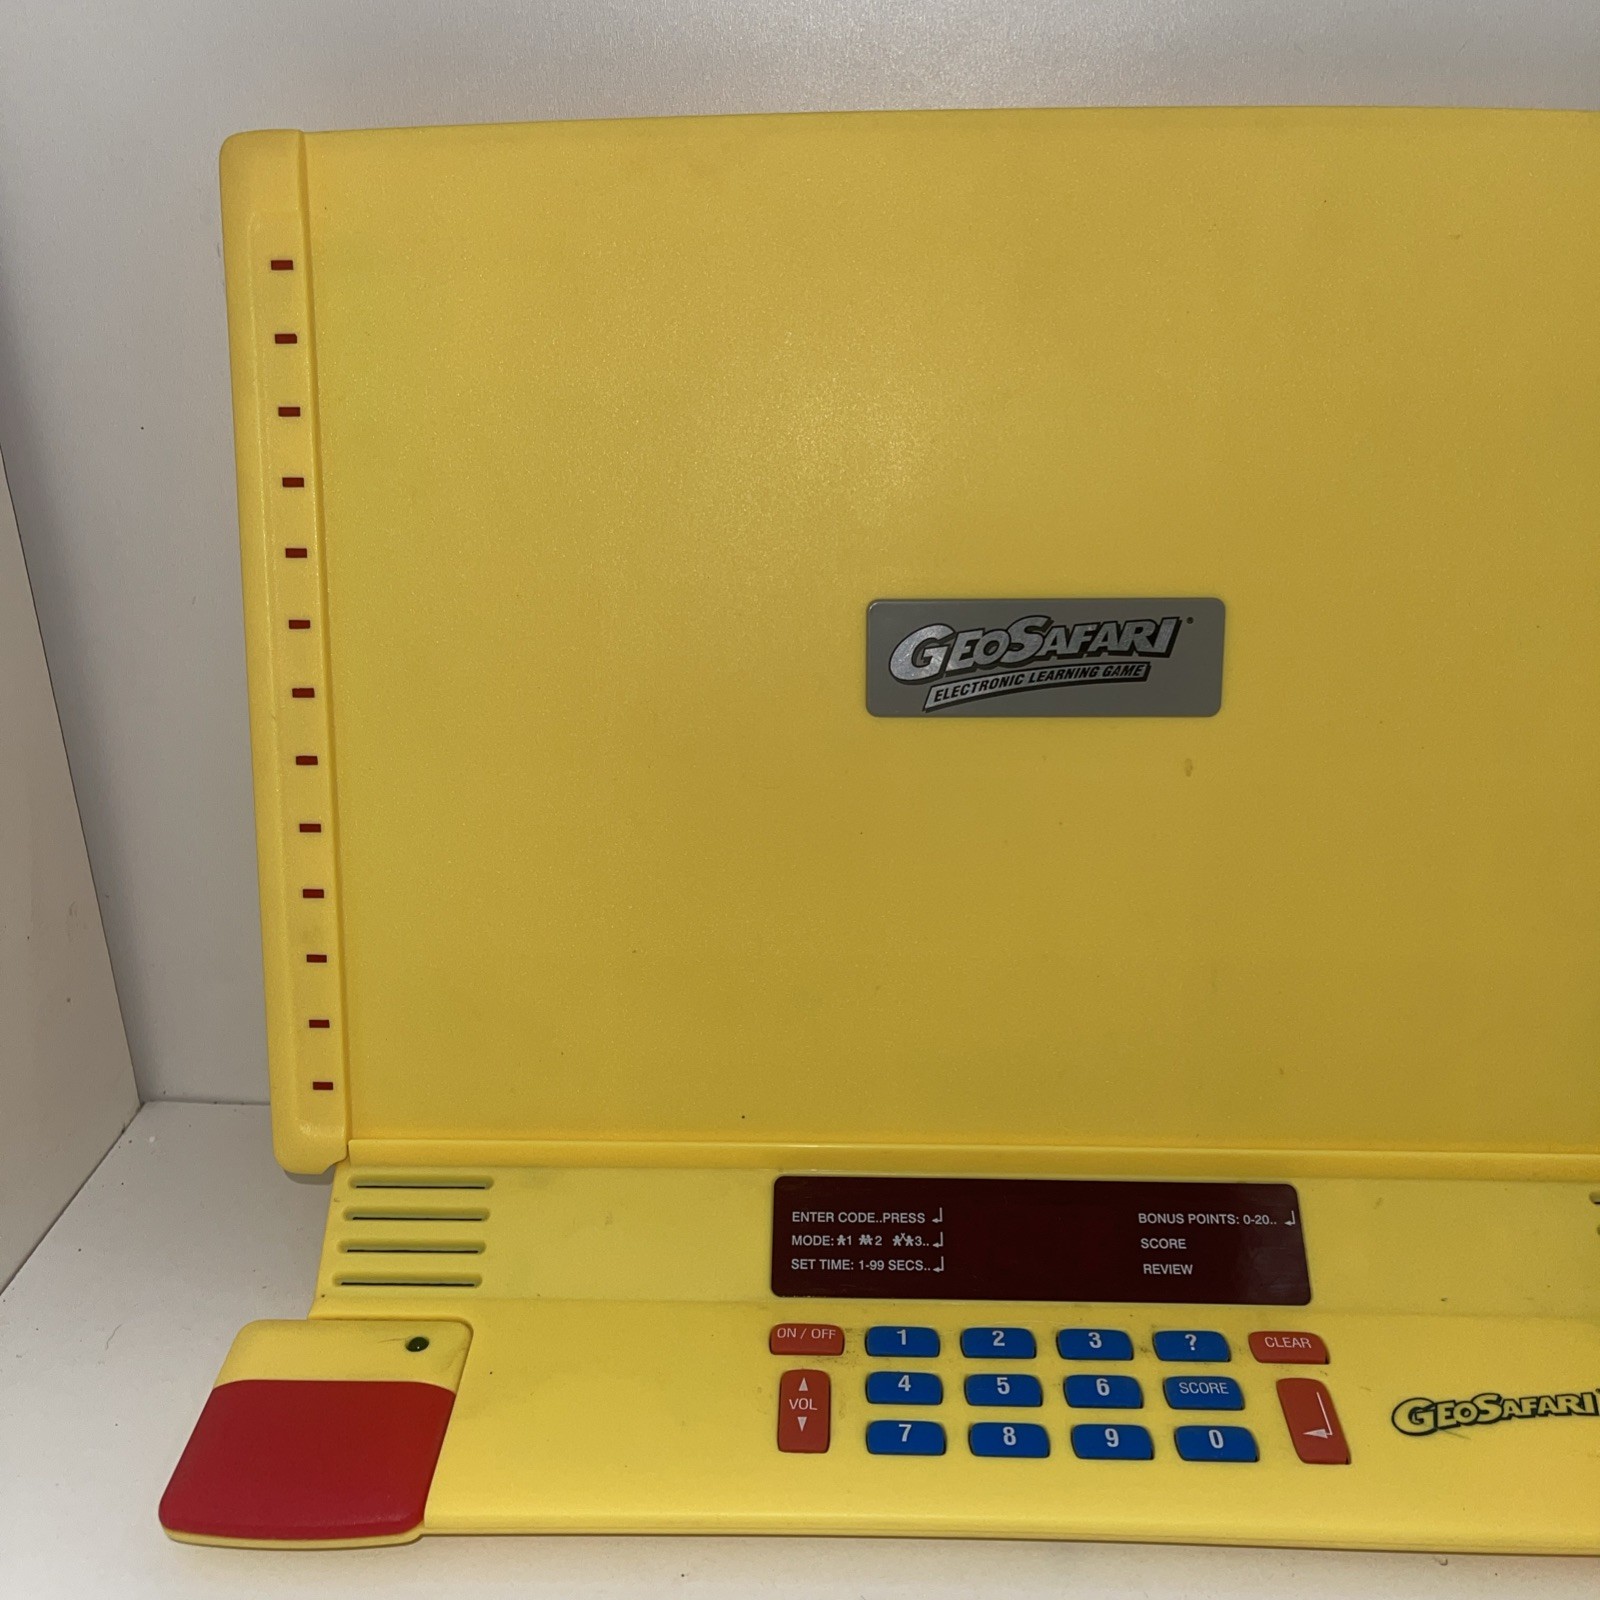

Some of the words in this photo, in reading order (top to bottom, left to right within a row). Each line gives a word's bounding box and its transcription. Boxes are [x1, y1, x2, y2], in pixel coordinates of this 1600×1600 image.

[889, 615, 1181, 685] GEOSAFARI
[934, 672, 1025, 702] ELECTRONIC
[1028, 664, 1099, 684] LEARNING
[1102, 663, 1146, 679] GAME
[791, 1211, 835, 1223] ENTER
[1138, 1213, 1185, 1224] BONUS
[1188, 1213, 1240, 1225] POINTS:
[791, 1234, 835, 1247] MODE:
[1140, 1238, 1187, 1249] SCORE
[791, 1258, 816, 1270] SET
[819, 1258, 854, 1271] TIME:
[858, 1259, 885, 1271] 1-99
[1142, 1263, 1194, 1275] REVIEW
[776, 1328, 797, 1339] ON
[811, 1328, 836, 1340] OFF
[896, 1329, 907, 1345] 1
[991, 1330, 1006, 1347] 2
[1088, 1332, 1102, 1349] 3
[1264, 1336, 1312, 1349] CLEAR
[897, 1374, 912, 1392] 4
[996, 1376, 1011, 1395] 5
[1095, 1378, 1111, 1397] 6
[1178, 1381, 1230, 1395] SCORE
[788, 1398, 818, 1411] VOL
[1391, 1392, 1599, 1436] GEOSAFARI
[898, 1423, 912, 1443] 7
[1002, 1426, 1017, 1446] 8
[1104, 1428, 1119, 1448] 9
[1207, 1429, 1224, 1449] 0
